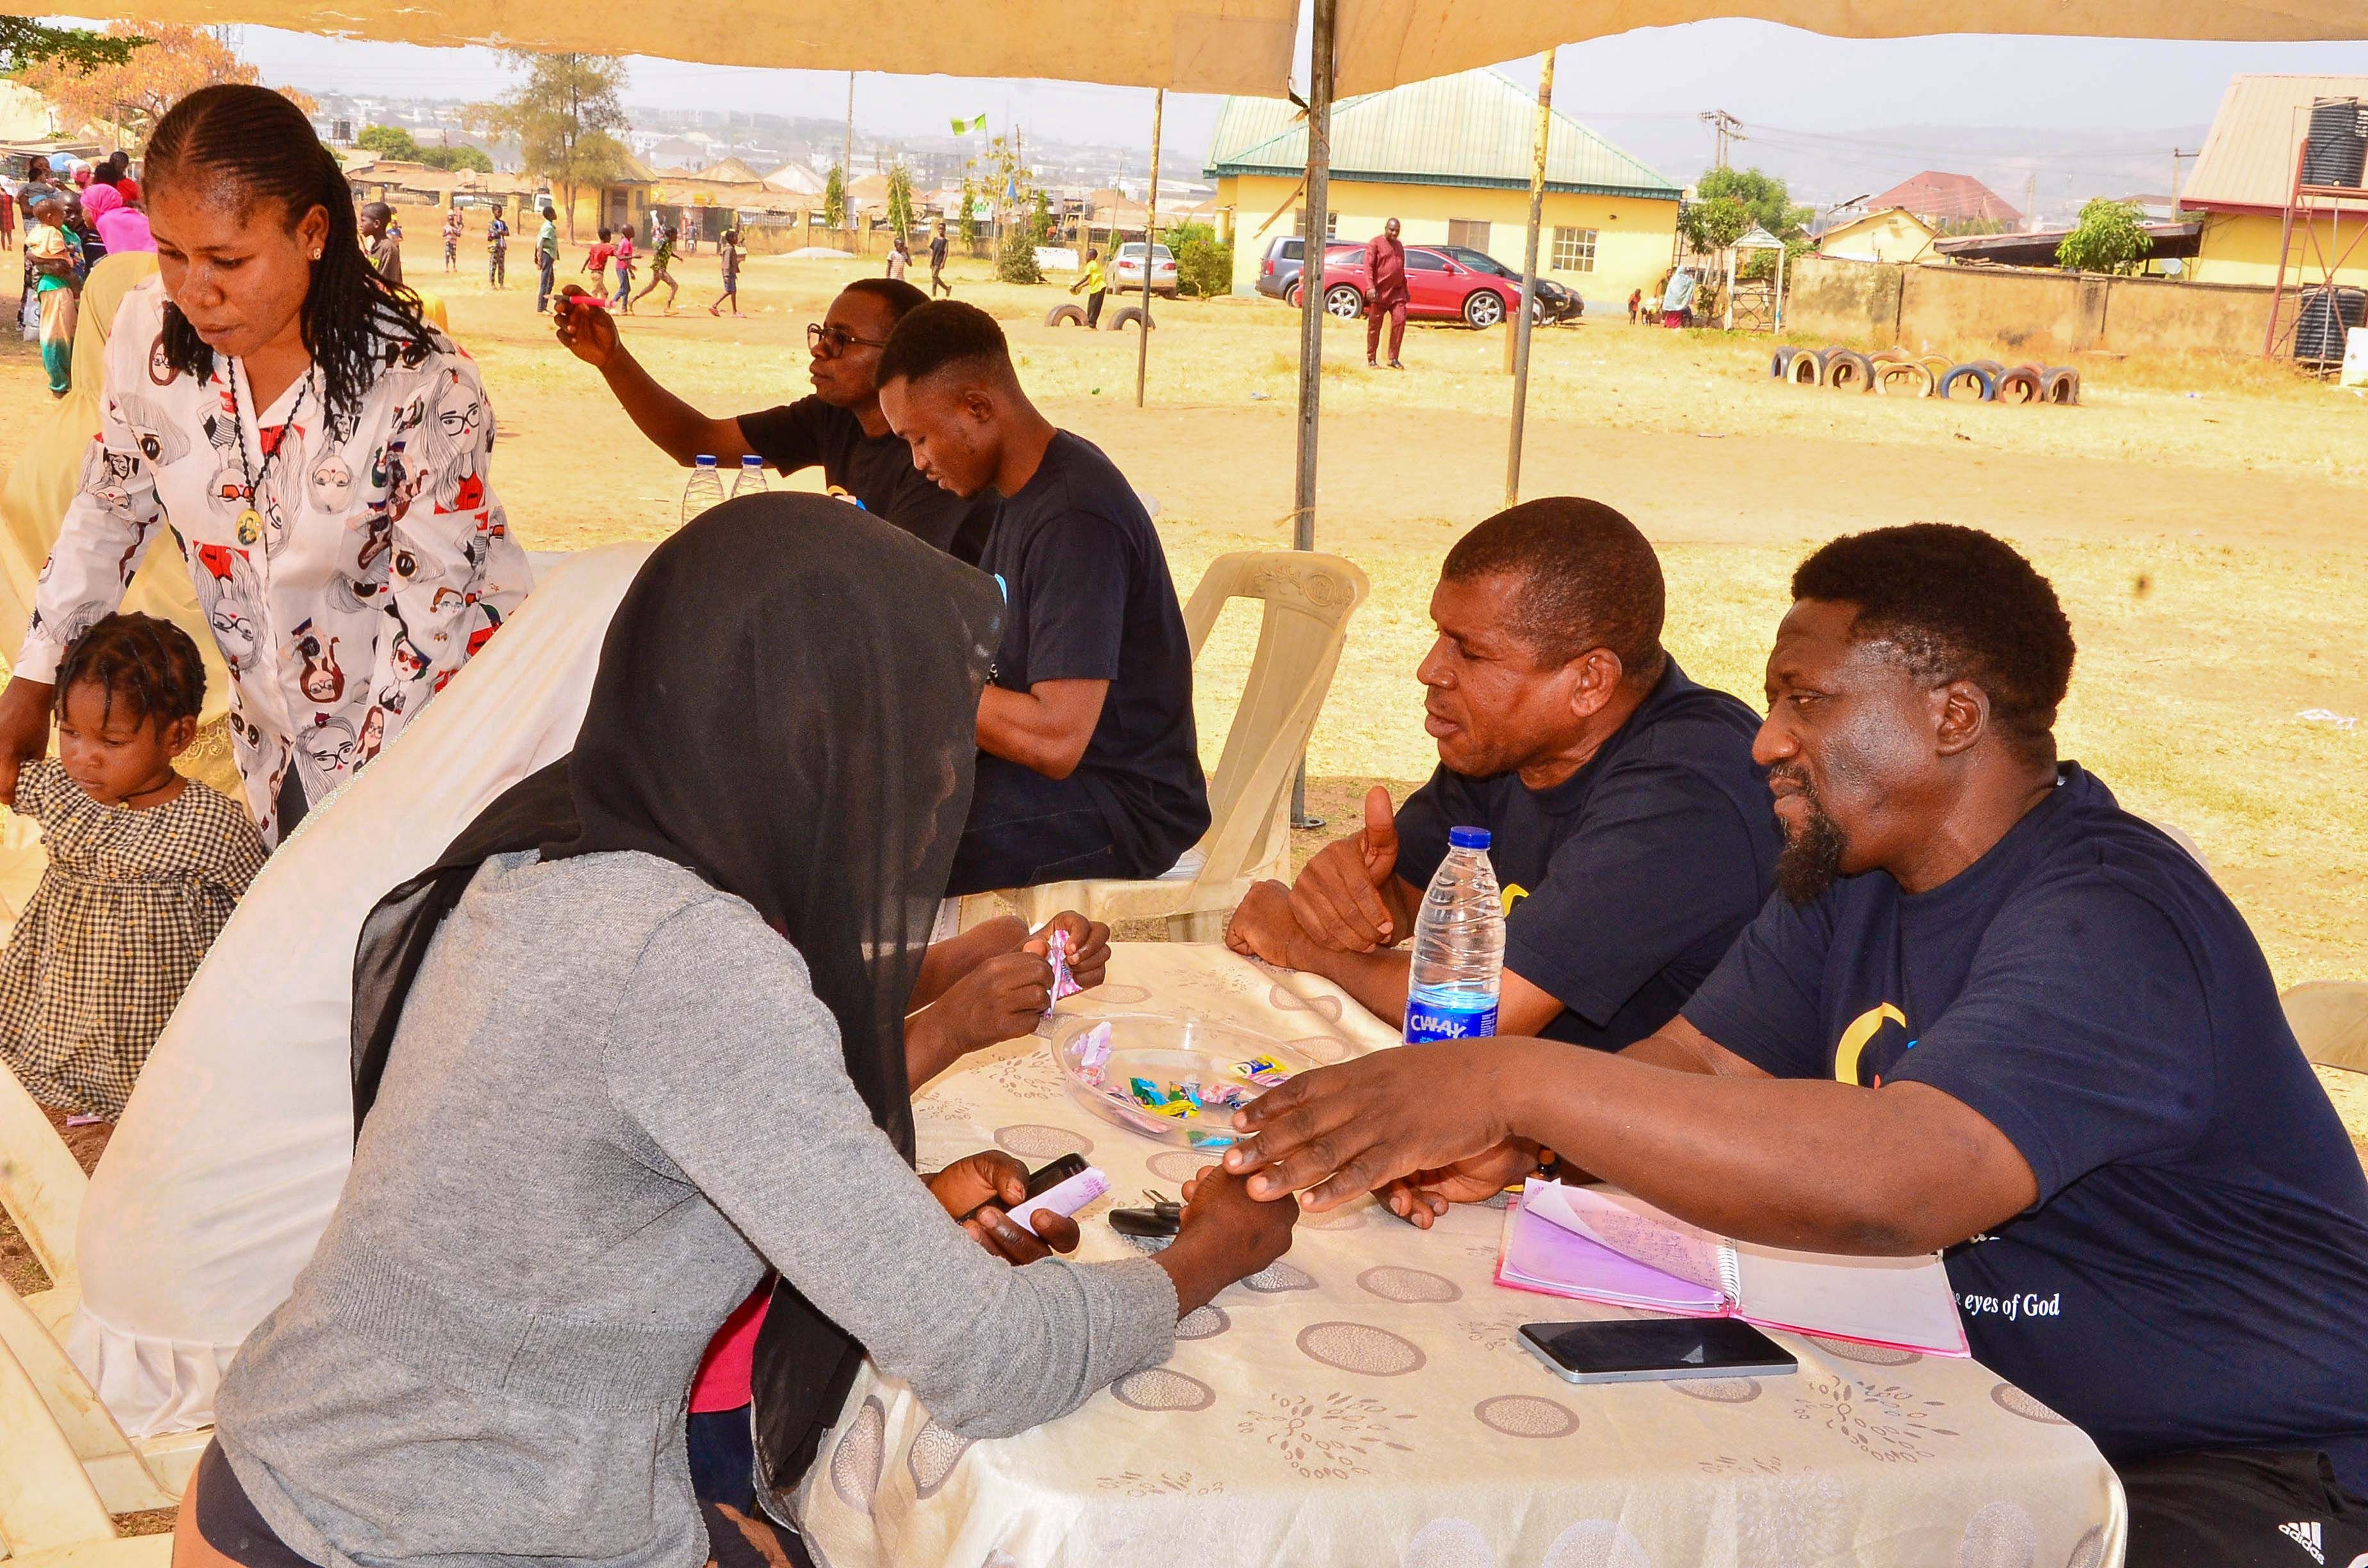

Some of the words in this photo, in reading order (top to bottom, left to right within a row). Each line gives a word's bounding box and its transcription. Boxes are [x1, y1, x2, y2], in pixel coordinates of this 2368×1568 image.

[1410, 1015, 1467, 1039] CWAY
[1964, 1294, 1999, 1316] eyes
[2002, 1293, 2021, 1321] of
[2023, 1293, 2060, 1317] God
[2278, 1524, 2324, 1565] adidas
